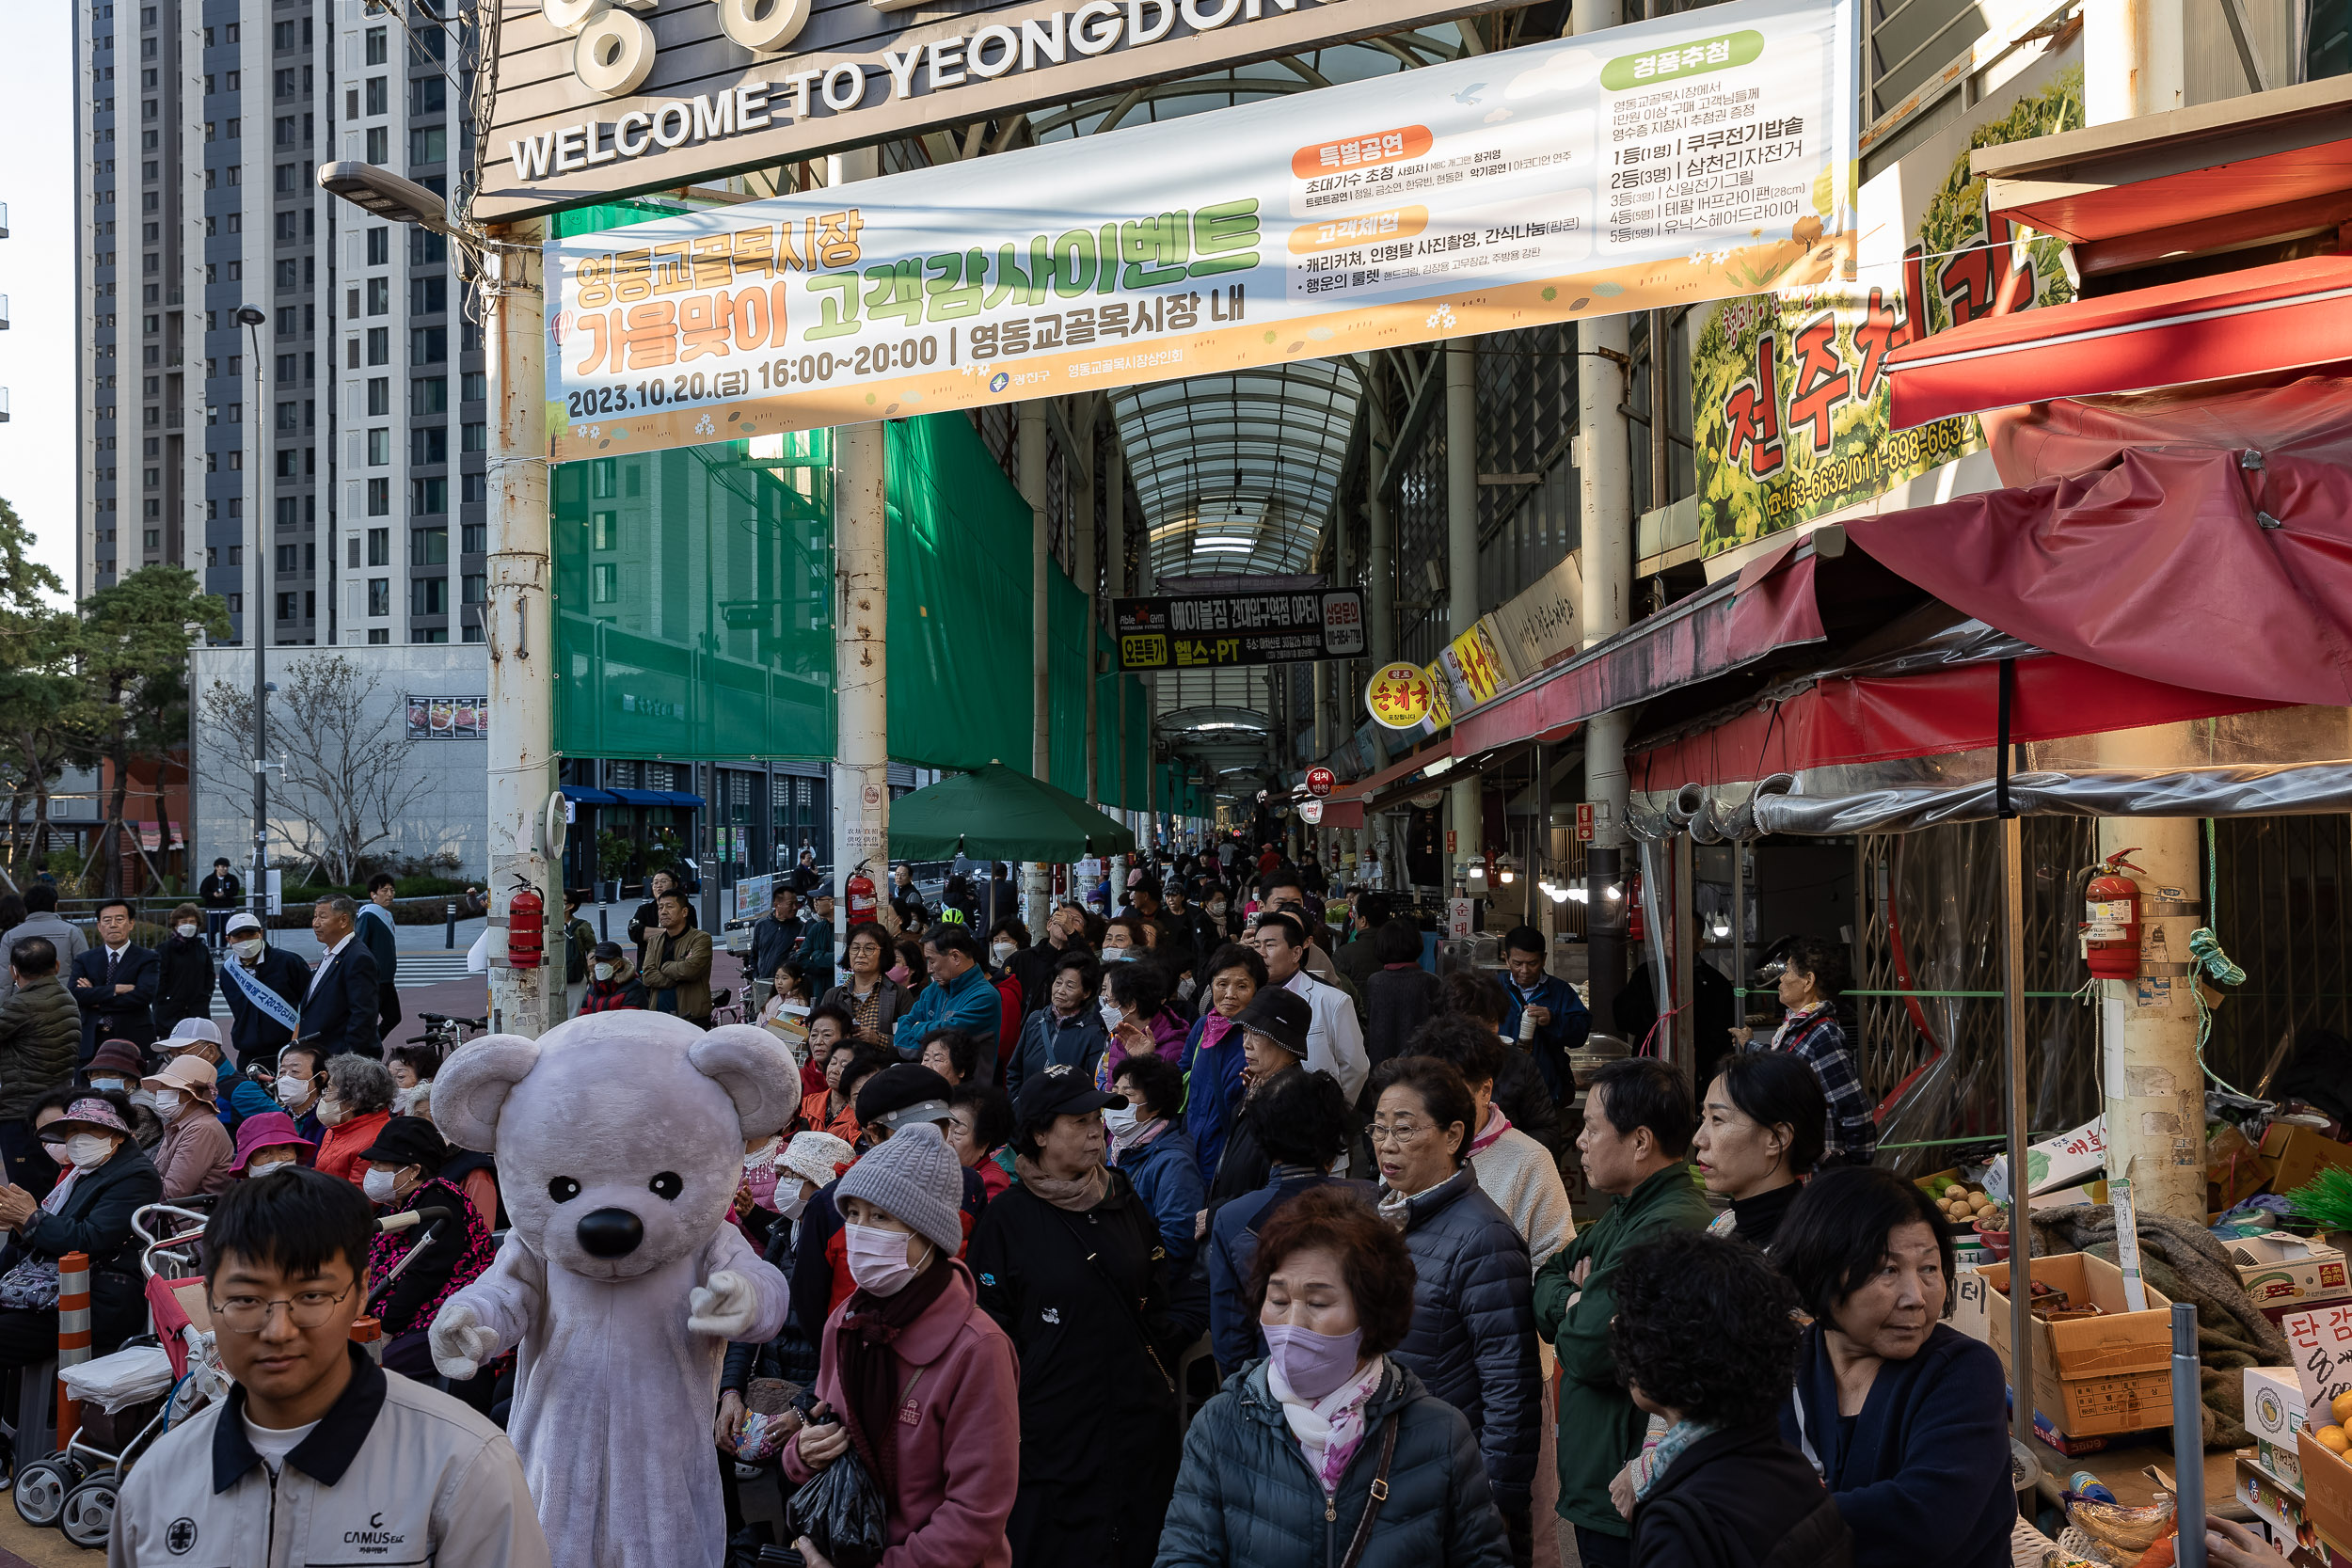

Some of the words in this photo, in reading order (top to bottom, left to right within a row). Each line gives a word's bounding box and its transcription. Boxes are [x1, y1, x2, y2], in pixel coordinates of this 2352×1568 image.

[1633, 39, 1731, 79] 경품추첨
[1613, 81, 1722, 113] 영동교골목시장에서
[1613, 110, 1641, 126] 1만원
[1644, 106, 1668, 120] 이상
[1671, 101, 1695, 116] 구매
[1698, 87, 1760, 111] 고객님들께
[508, 81, 771, 181] WELCOME
[785, 62, 866, 118] TO
[1613, 126, 1648, 143] 영수증
[1651, 118, 1688, 135] 지참시
[1691, 112, 1727, 128] 추첨권
[1730, 103, 1756, 119] 증정
[1319, 133, 1405, 168] 특별공연
[1613, 143, 1672, 166] 1등(1명)
[1687, 116, 1804, 153] 쿠쿠전기밥솥
[1306, 171, 1362, 196] 초대가수
[1365, 166, 1394, 184] 초청
[1397, 164, 1424, 178] 사회자
[1430, 159, 1446, 171] MBC
[1447, 154, 1472, 168] 개그맨
[1473, 149, 1502, 164] 정귀영
[1306, 190, 1348, 209] 트로트공연
[1355, 187, 1375, 200] 정일,
[1406, 174, 1435, 191] 한유빈,
[1470, 164, 1507, 179] 악기공연
[1514, 154, 1551, 171] 아코디언
[1551, 150, 1573, 165] 연주
[1611, 166, 1672, 190] 2등(3명)
[1686, 139, 1803, 179] 삼천리자전거
[1611, 189, 1655, 208] 3등(3명)
[1665, 169, 1755, 199] 신일전기그릴
[1314, 211, 1400, 245] 고객체험
[1610, 207, 1654, 226] 4등(5명)
[1665, 198, 1695, 217] 테팔
[1610, 226, 1654, 243] 5등(5명)
[1664, 199, 1799, 235] 유닉스헤어드라이어
[576, 209, 865, 310] 영동교골목시장
[1306, 251, 1366, 274] 캐리커쳐,
[1370, 243, 1415, 263] 인형탈
[1417, 232, 1482, 257] 사진촬영,
[577, 280, 788, 377] 가을맞이
[803, 198, 1262, 342] 고객감사이벤트
[1306, 277, 1348, 294] 행운의
[1351, 268, 1380, 287] 룰렛
[1383, 265, 1422, 282] 핸드크림,
[1422, 261, 1450, 276] 김장용
[1452, 255, 1490, 272] 고무장갑,
[1492, 250, 1520, 265] 주방용
[568, 367, 750, 420] 2023.10.20.(금)
[757, 335, 938, 391] 16:00~20:00
[970, 290, 1202, 360] 영동교골목시장
[1211, 282, 1246, 323] 내
[1012, 370, 1051, 386] 광진구
[1068, 349, 1184, 378] 영동교골목시장상인회
[1150, 613, 1166, 625] GYM
[1170, 599, 1229, 631] 에이블짐
[1230, 596, 1291, 628] 건대입구역점
[1291, 594, 1320, 625] OPEN
[1326, 601, 1359, 626] 상담문의
[1125, 638, 1165, 664] 오픈특가
[1246, 638, 1259, 651] 주소:
[1259, 636, 1281, 650] 아차산로
[1372, 679, 1430, 712] 순대국
[1388, 713, 1416, 721] 포장됩니다
[1312, 771, 1329, 782] 김치
[1312, 784, 1330, 794] 반찬
[1307, 806, 1318, 817] 떡
[898, 1414, 919, 1426] PARIS
[343, 1531, 391, 1544] CAMUS
